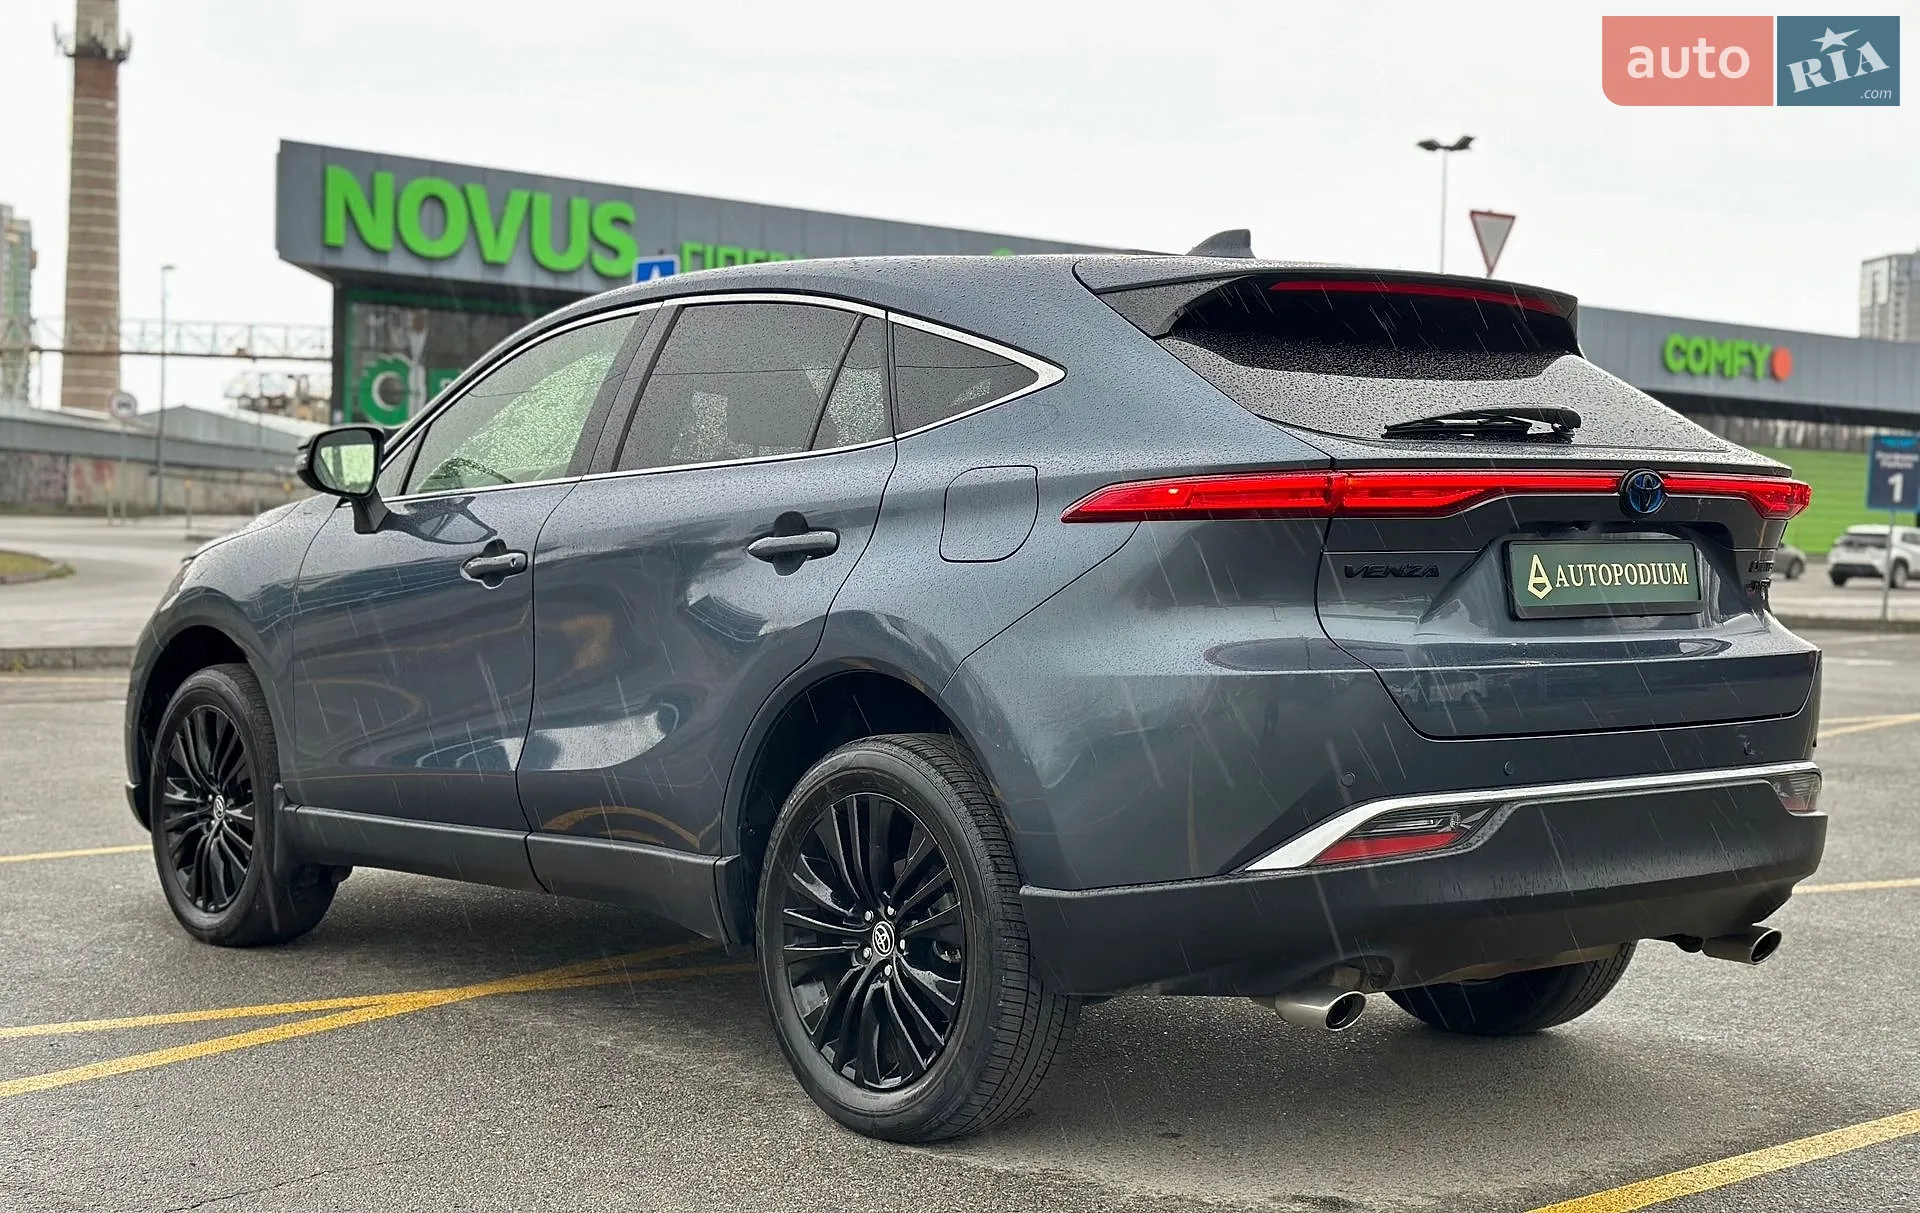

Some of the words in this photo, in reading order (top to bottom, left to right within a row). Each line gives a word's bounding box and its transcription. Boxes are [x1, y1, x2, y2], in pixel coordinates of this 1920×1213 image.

[323, 164, 639, 277] NOVUS
[1664, 333, 1771, 380] COMFY
[1887, 472, 1904, 503] 1
[1344, 564, 1439, 578] VENZA
[1555, 562, 1689, 588] AUTOPODIUM
